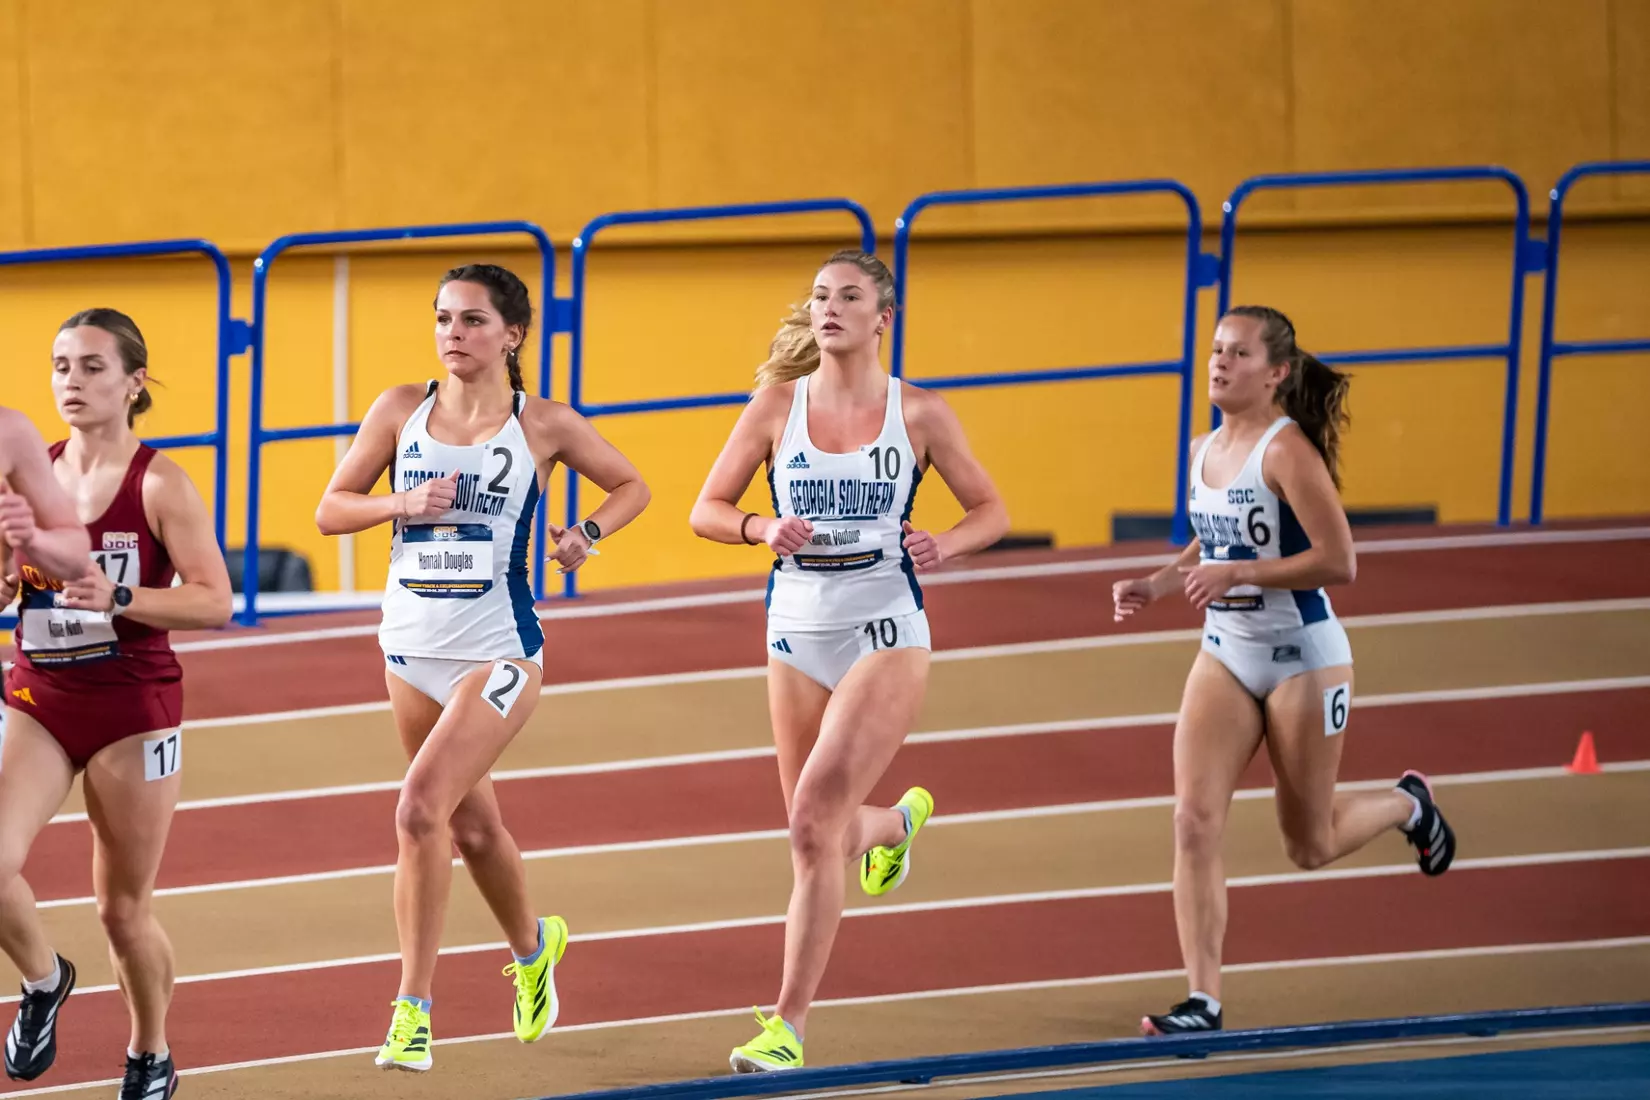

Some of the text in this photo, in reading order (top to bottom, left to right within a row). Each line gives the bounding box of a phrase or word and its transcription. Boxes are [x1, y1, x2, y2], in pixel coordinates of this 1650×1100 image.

[487, 446, 513, 495] 2
[868, 446, 901, 481] 10
[789, 478, 897, 517] GEORGIA SOUTHERN
[1228, 488, 1255, 505] SBC
[102, 532, 139, 550] SBC
[1247, 505, 1271, 547] 6
[95, 552, 129, 583] 17
[418, 551, 473, 572] Hannah Douglas
[864, 617, 898, 650] 10
[488, 664, 520, 712] 2
[1331, 688, 1346, 730] 6
[153, 733, 177, 776] 17
